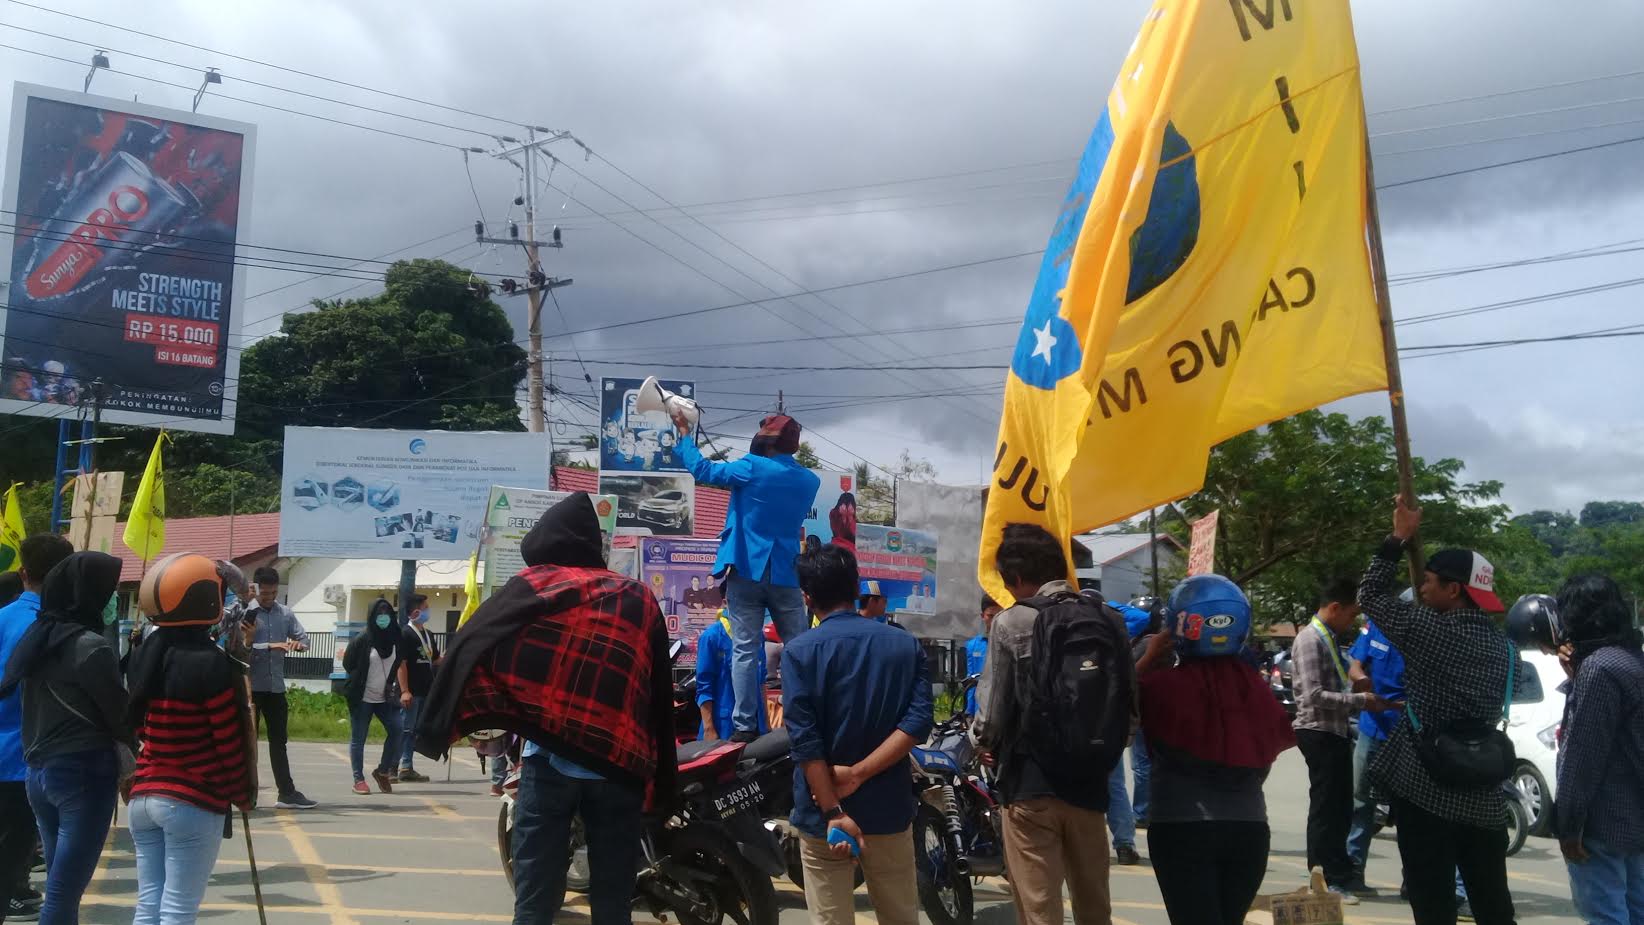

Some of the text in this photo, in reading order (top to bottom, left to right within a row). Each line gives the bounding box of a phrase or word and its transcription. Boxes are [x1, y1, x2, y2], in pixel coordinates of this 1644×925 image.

[70, 185, 149, 260] PRO
[40, 251, 84, 289] Surya
[138, 272, 222, 301] STRENGTH
[112, 288, 221, 320] MEETS STYLE
[129, 320, 214, 346] RP 15.000
[158, 351, 214, 365] ISI 16 BATANG
[617, 511, 636, 519] ORLD
[714, 780, 761, 811] DC 3693 AW
